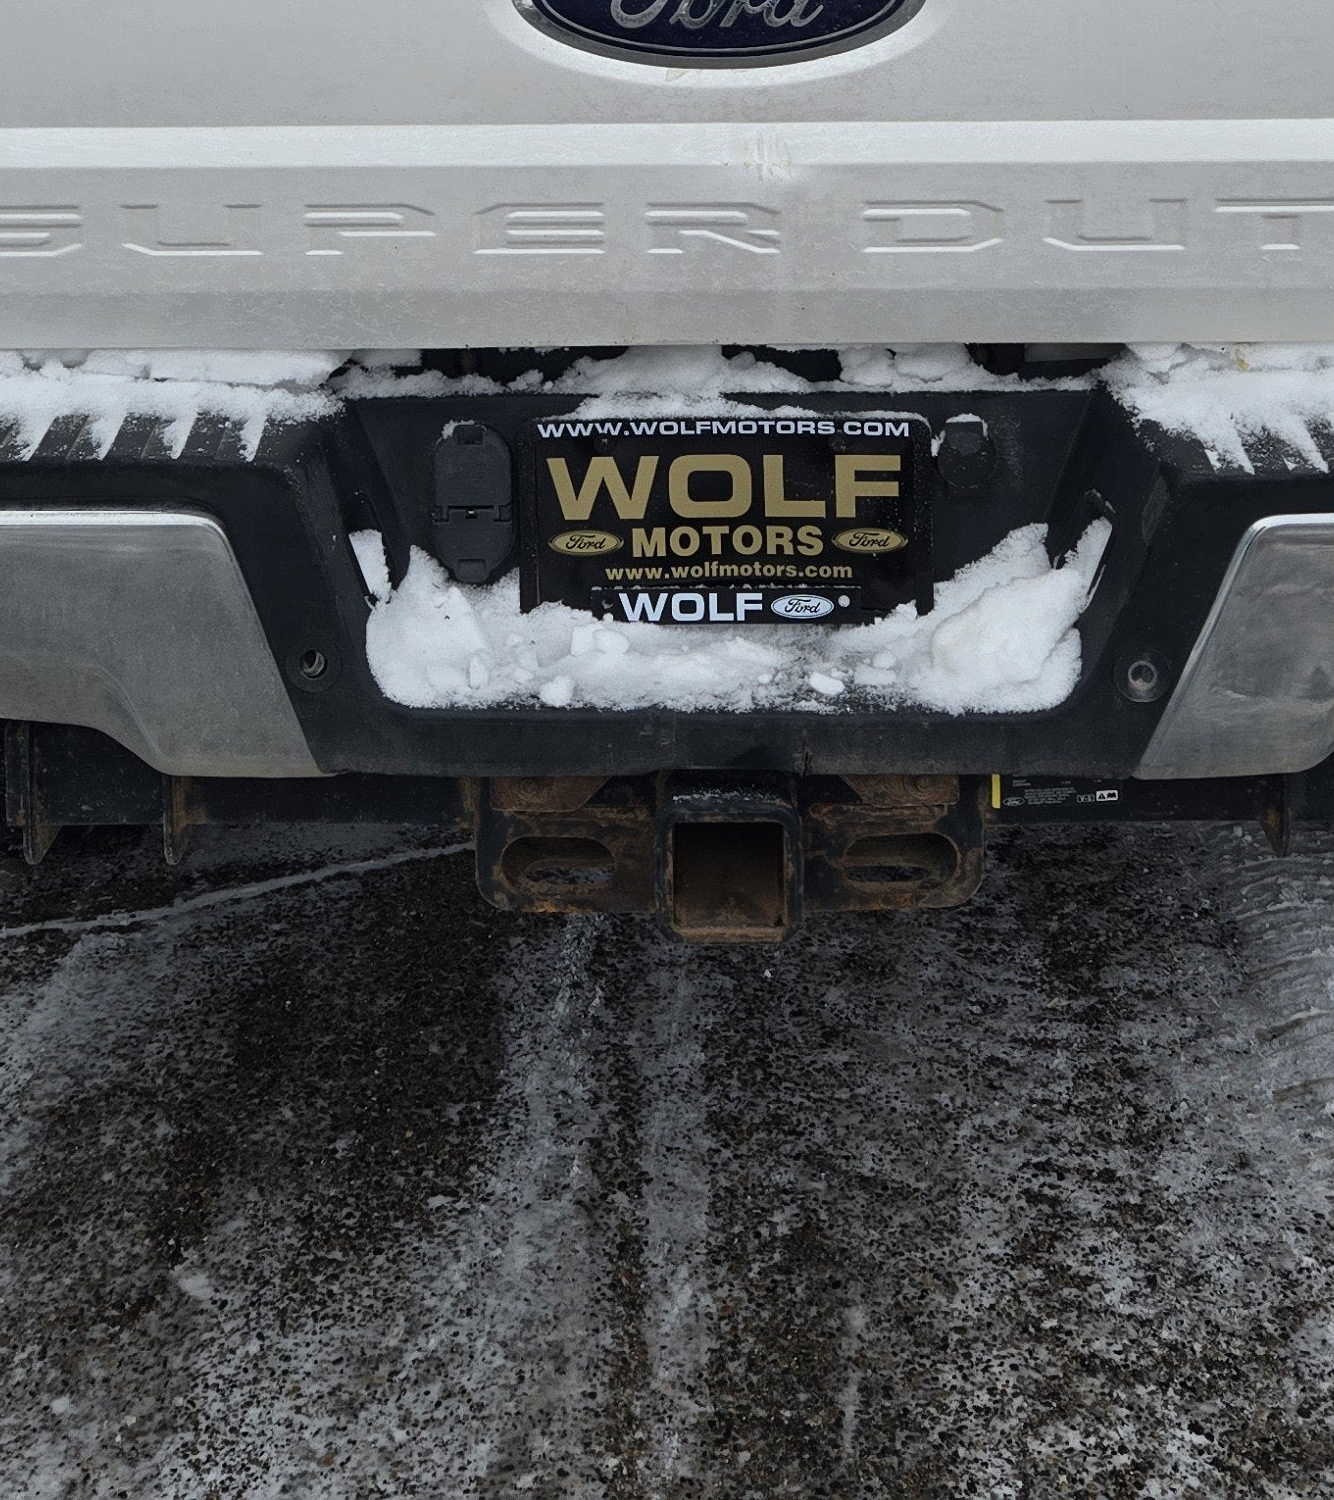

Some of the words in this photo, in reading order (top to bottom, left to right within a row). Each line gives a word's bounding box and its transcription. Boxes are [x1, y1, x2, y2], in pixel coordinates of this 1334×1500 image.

[546, 454, 901, 521] WOLF
[565, 534, 607, 551] Ford
[632, 526, 824, 558] MOTORS
[848, 531, 889, 550] Ford
[605, 561, 853, 581] www.wolfmotors.com
[618, 593, 763, 622] WOLF
[783, 598, 822, 615] Ford
